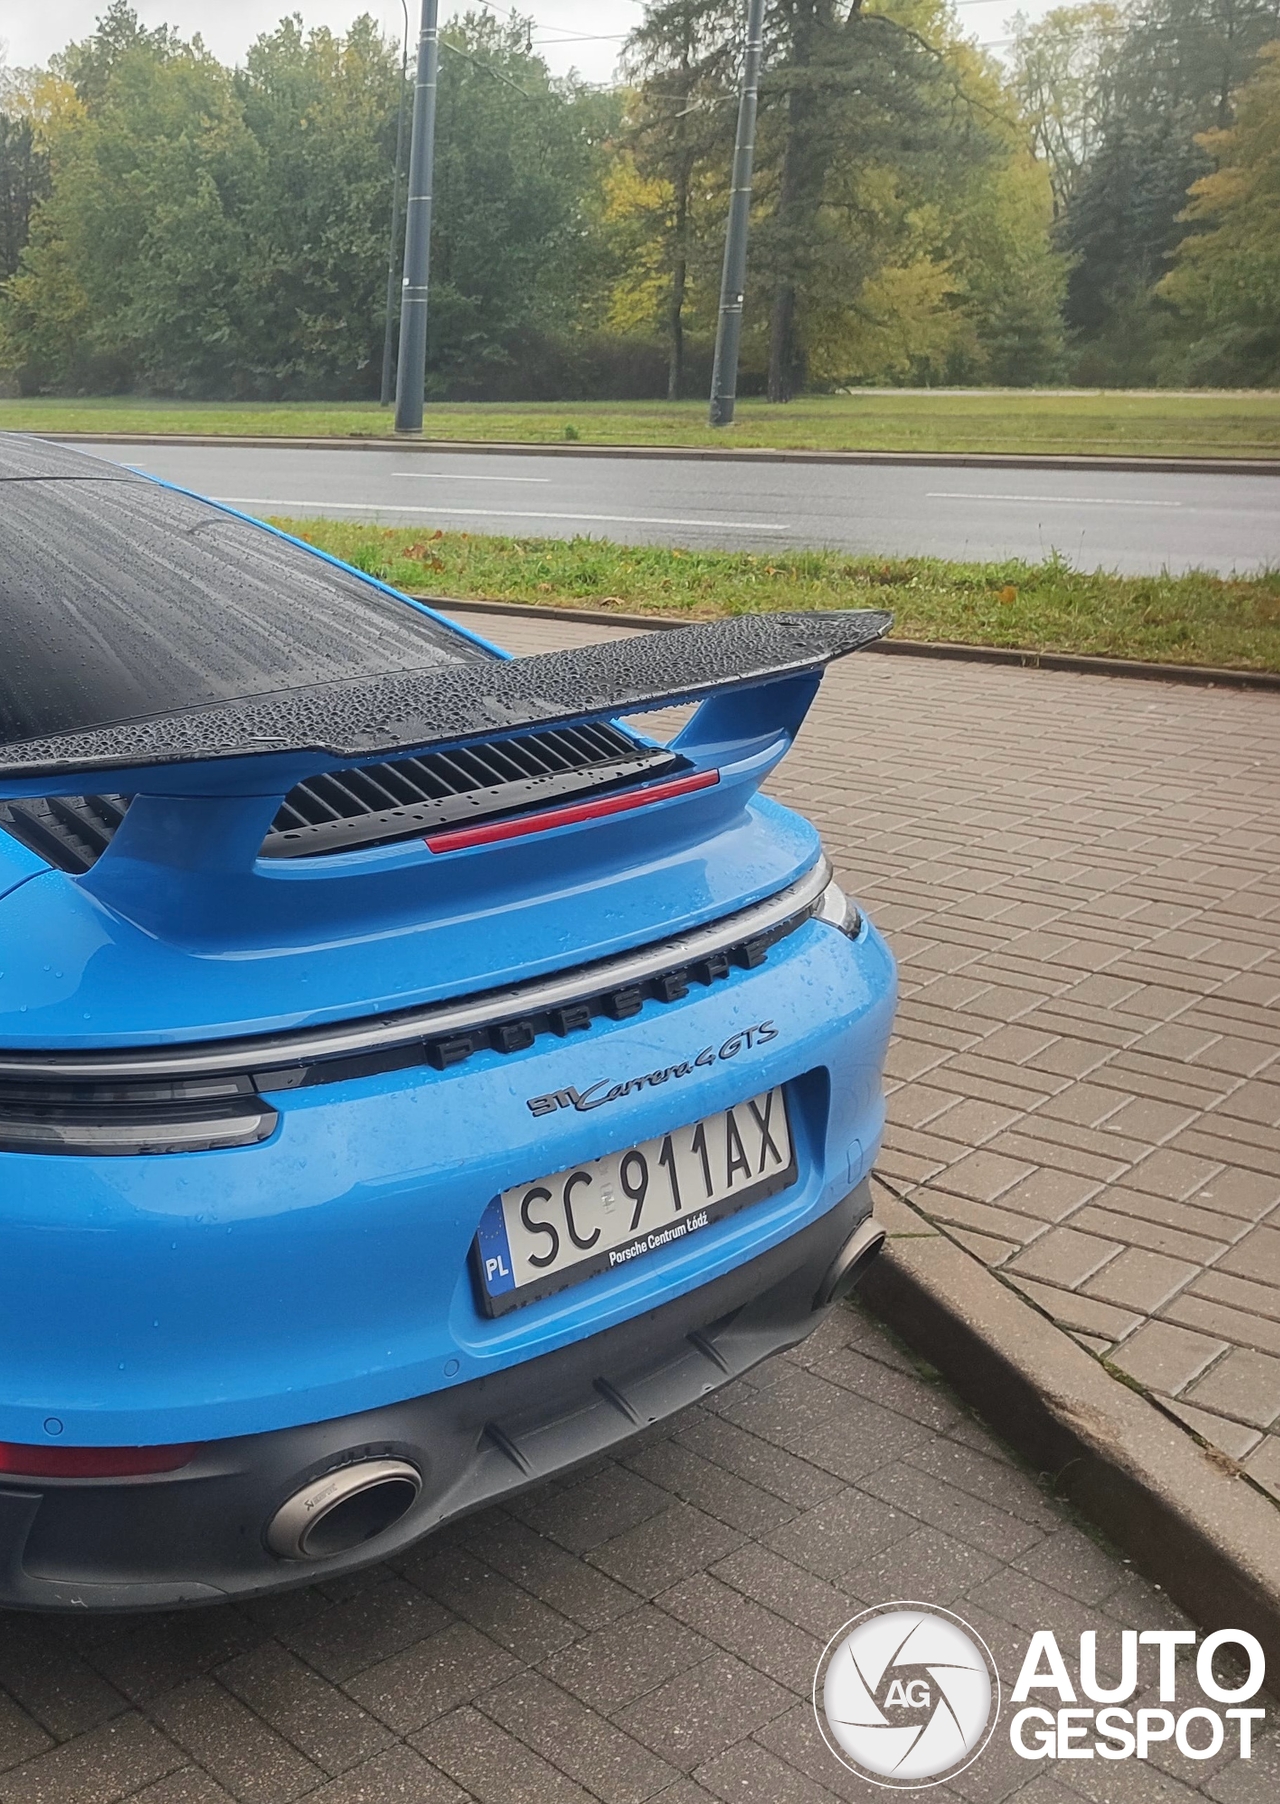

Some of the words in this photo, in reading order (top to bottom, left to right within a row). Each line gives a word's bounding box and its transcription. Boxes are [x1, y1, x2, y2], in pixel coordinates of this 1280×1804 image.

[526, 1086, 580, 1118] 911
[574, 1061, 694, 1112] Carrera
[694, 1045, 717, 1067] 4
[718, 1019, 779, 1060] GTS
[520, 1170, 602, 1268] SC
[620, 1090, 783, 1233] 911AX
[485, 1255, 509, 1282] PL
[608, 1240, 648, 1267] Porsche
[647, 1223, 687, 1250] Centrum
[686, 1210, 709, 1233] Łódź
